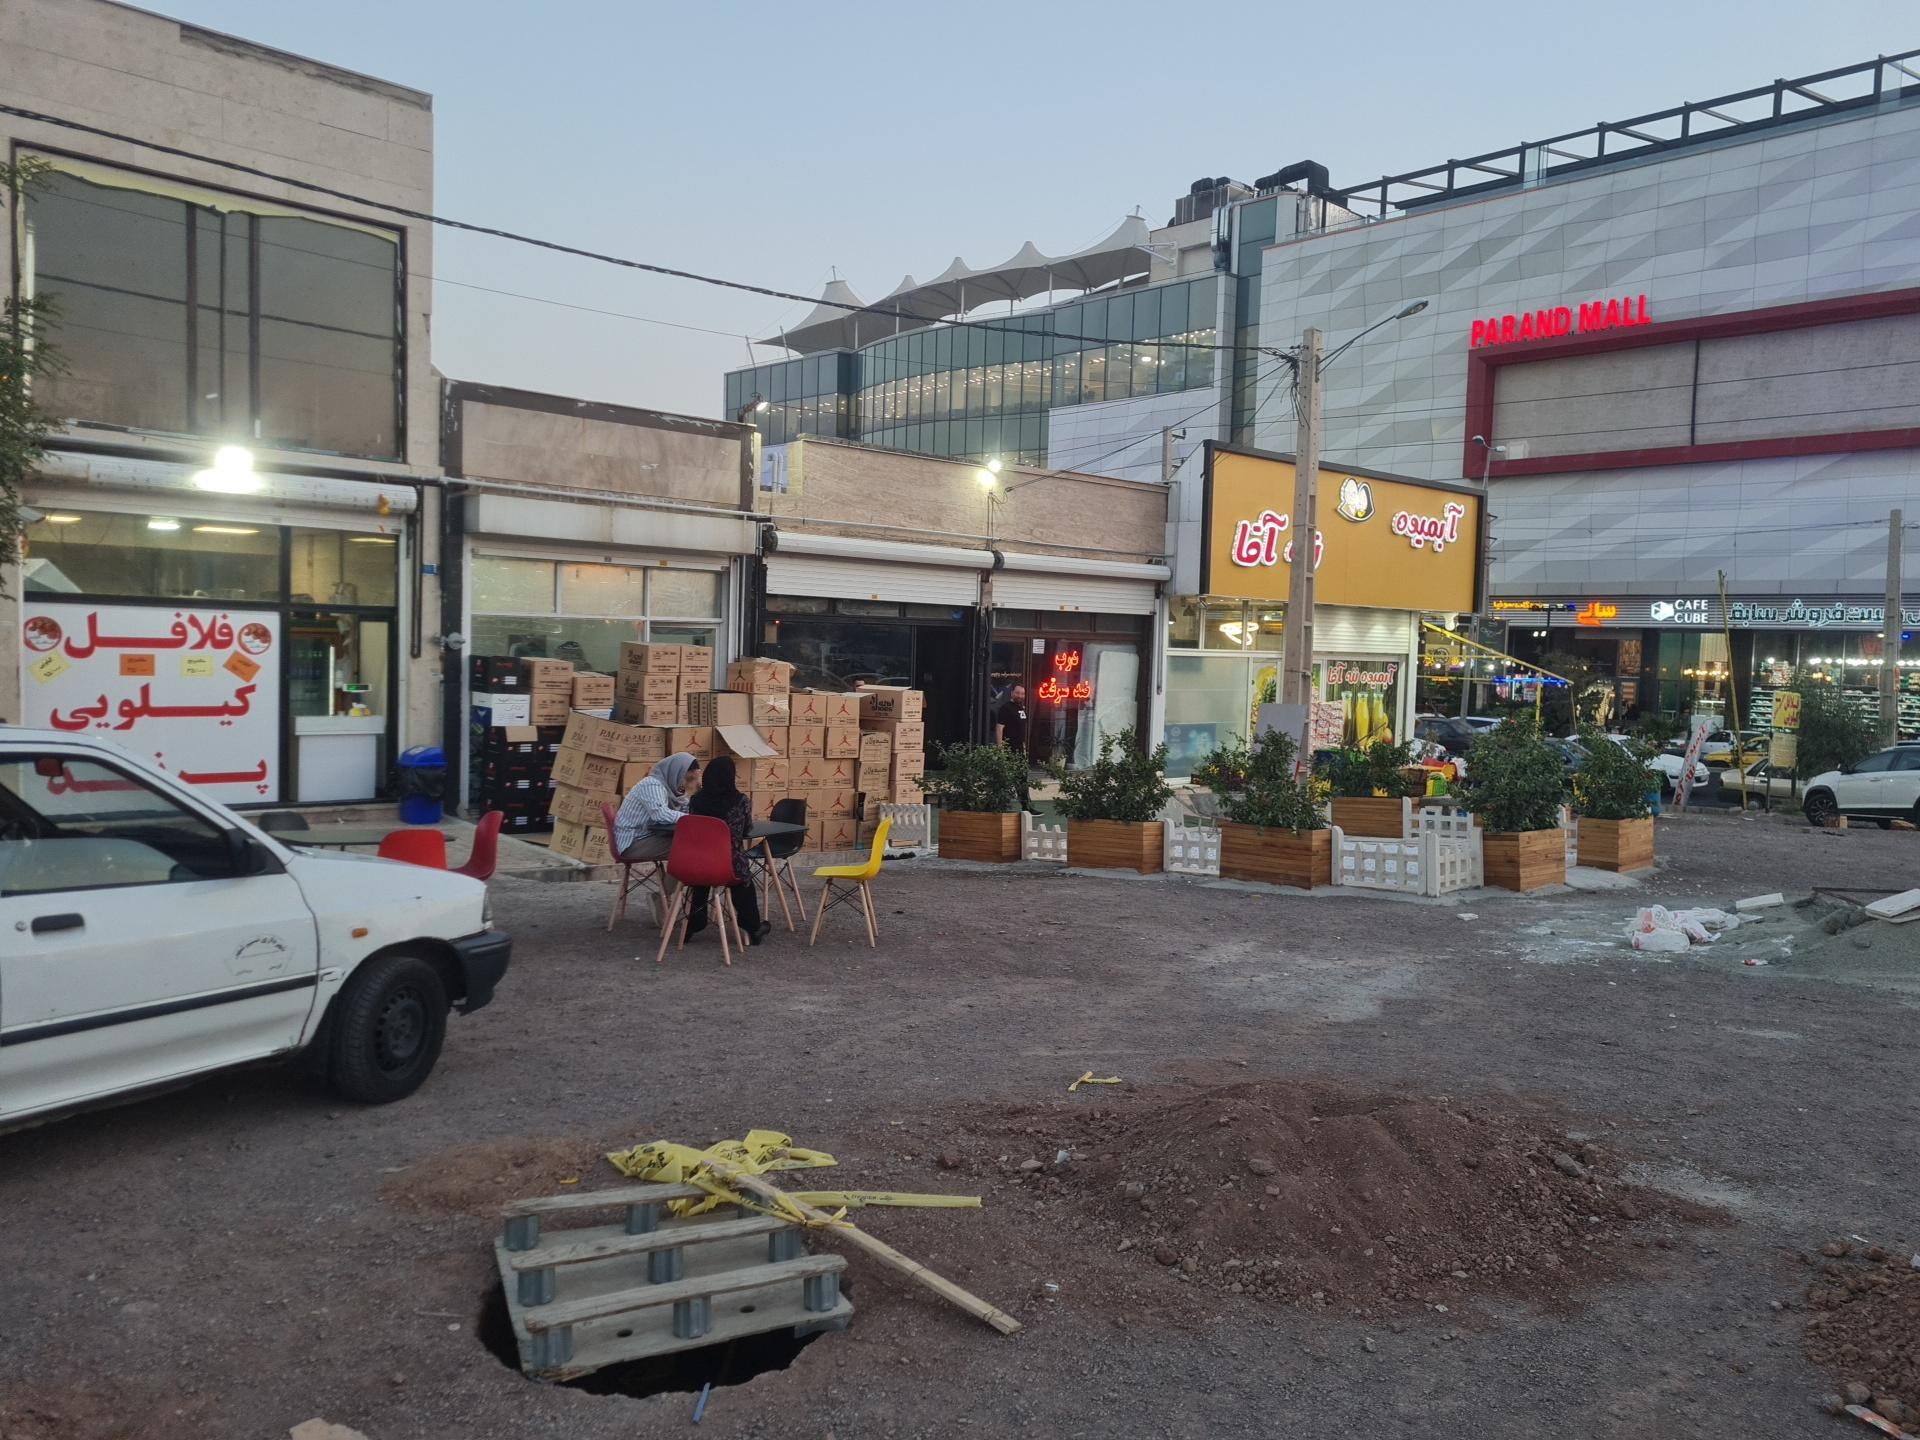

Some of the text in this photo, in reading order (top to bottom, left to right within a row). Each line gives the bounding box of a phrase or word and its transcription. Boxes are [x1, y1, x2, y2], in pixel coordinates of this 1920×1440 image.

[1471, 294, 1651, 348] PARAND MALL
[1394, 502, 1465, 552] آبمیوه
[1675, 600, 1709, 610] CAFE
[1675, 613, 1709, 623] CUBE
[1780, 598, 1846, 628] فروش
[64, 611, 235, 660] فلافل
[50, 683, 257, 731] کیلویی
